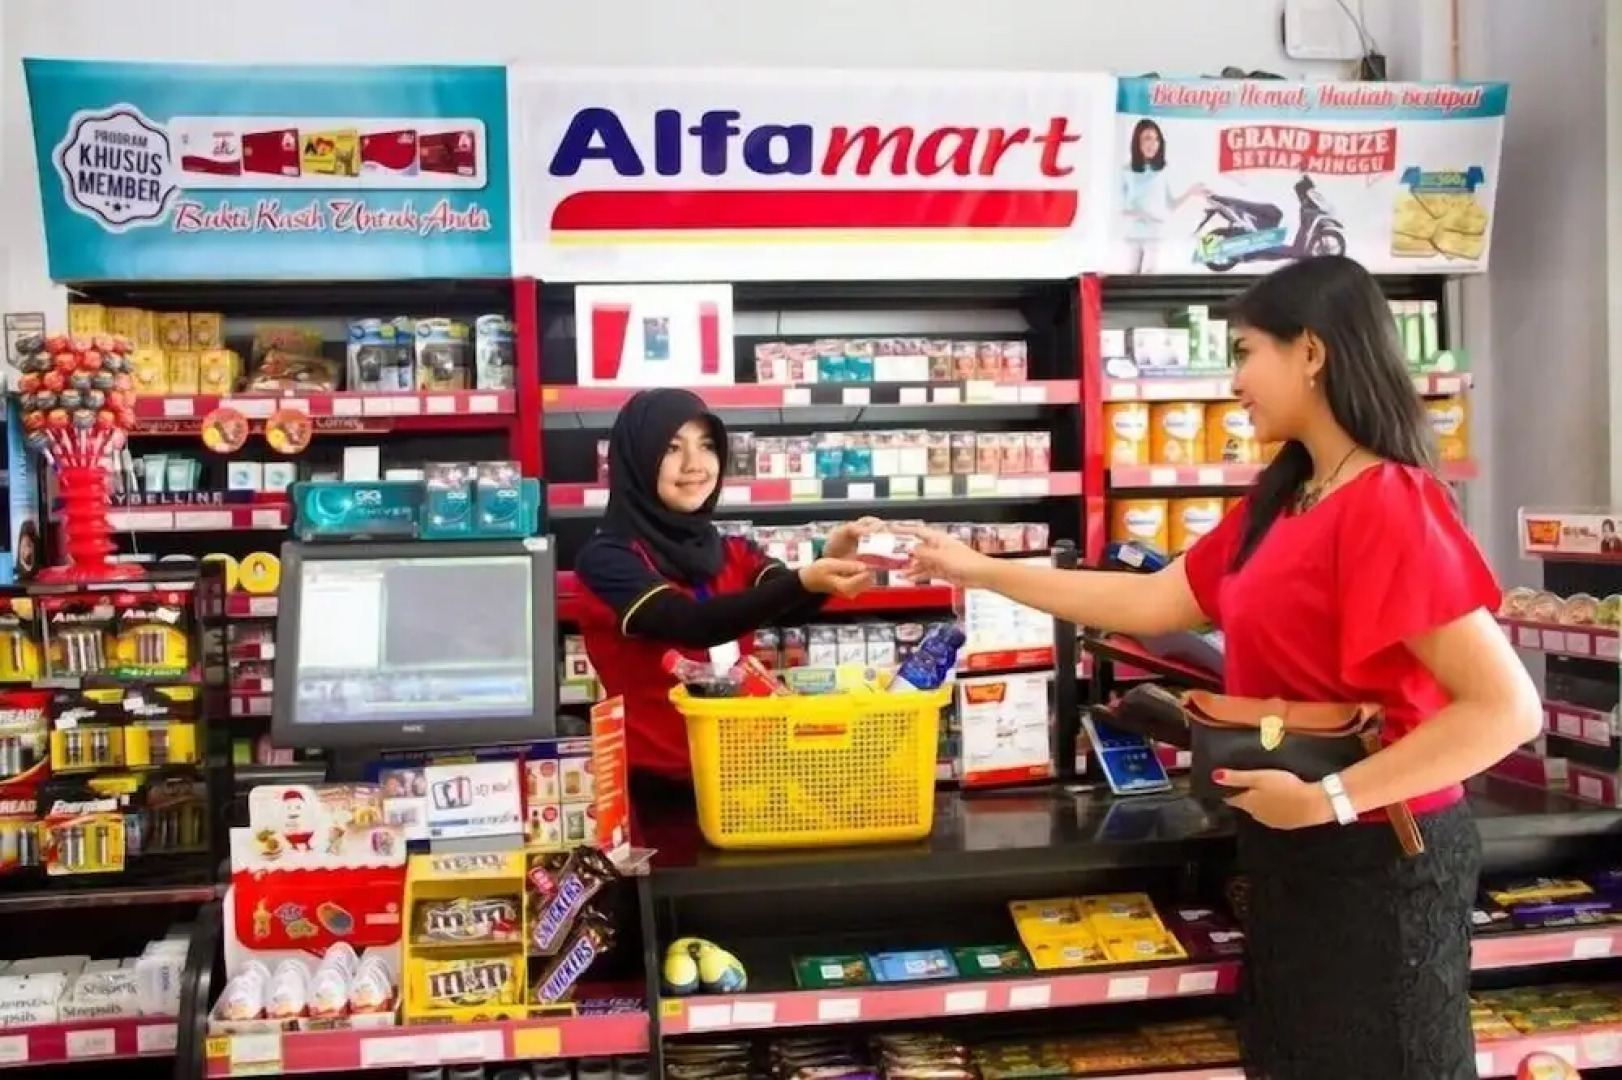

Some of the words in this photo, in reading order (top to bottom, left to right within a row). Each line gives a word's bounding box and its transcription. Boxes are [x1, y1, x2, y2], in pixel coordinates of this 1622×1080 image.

[94, 129, 148, 147] PROGRAM
[549, 107, 1082, 177] Alfamart
[1226, 128, 1311, 151] GRAND
[1317, 131, 1389, 155] PRIZE
[79, 143, 163, 176] KHUSUS
[1232, 149, 1302, 168] SETIAP
[1308, 154, 1384, 173] MINGGU
[78, 169, 161, 202] MEMBER
[175, 202, 249, 231] Bukti
[254, 201, 324, 231] Kasih
[329, 201, 417, 232] Untuk
[418, 201, 490, 235] Anda
[104, 491, 223, 506] YBELLINE
[537, 878, 582, 945] SNICKERS
